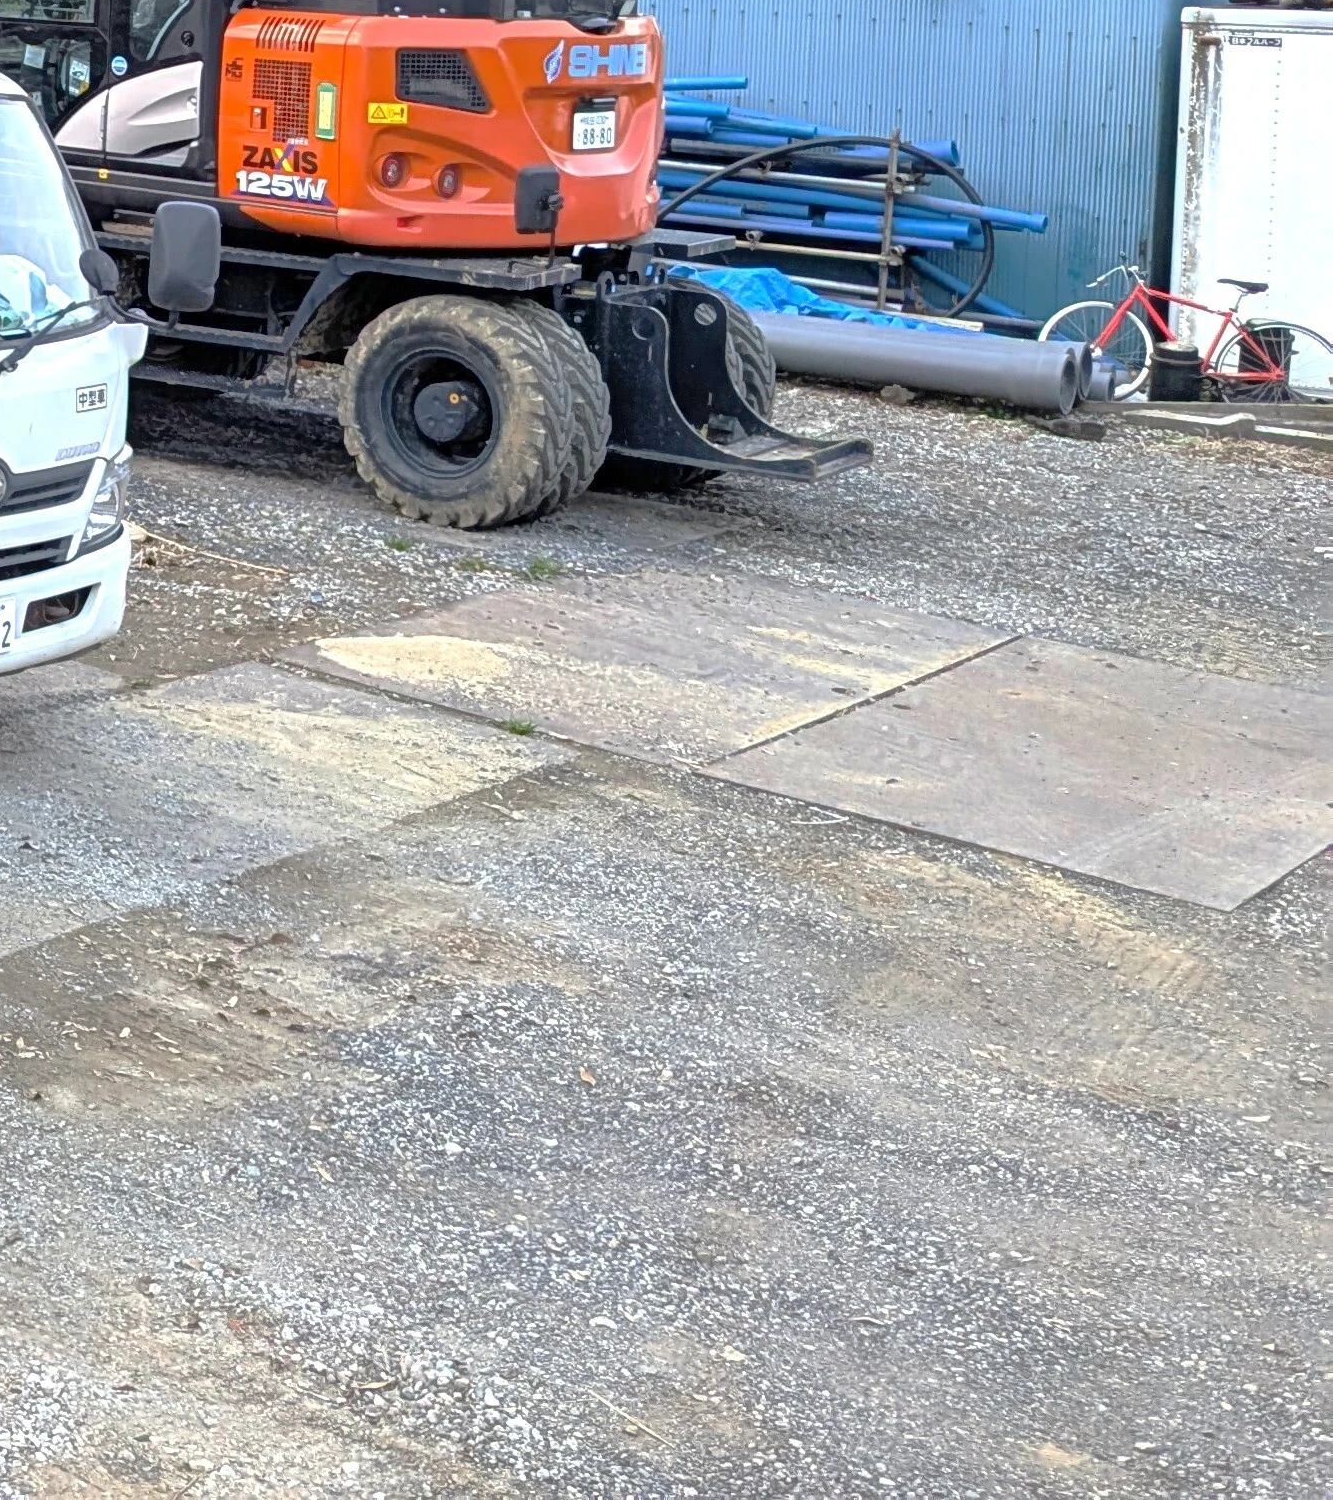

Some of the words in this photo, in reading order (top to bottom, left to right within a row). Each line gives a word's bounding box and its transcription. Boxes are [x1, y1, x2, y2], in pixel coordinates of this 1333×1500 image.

[583, 126, 612, 146] 88-80
[242, 144, 318, 174] ZAXIS
[236, 170, 327, 201] 125W
[78, 388, 106, 407] 中型車
